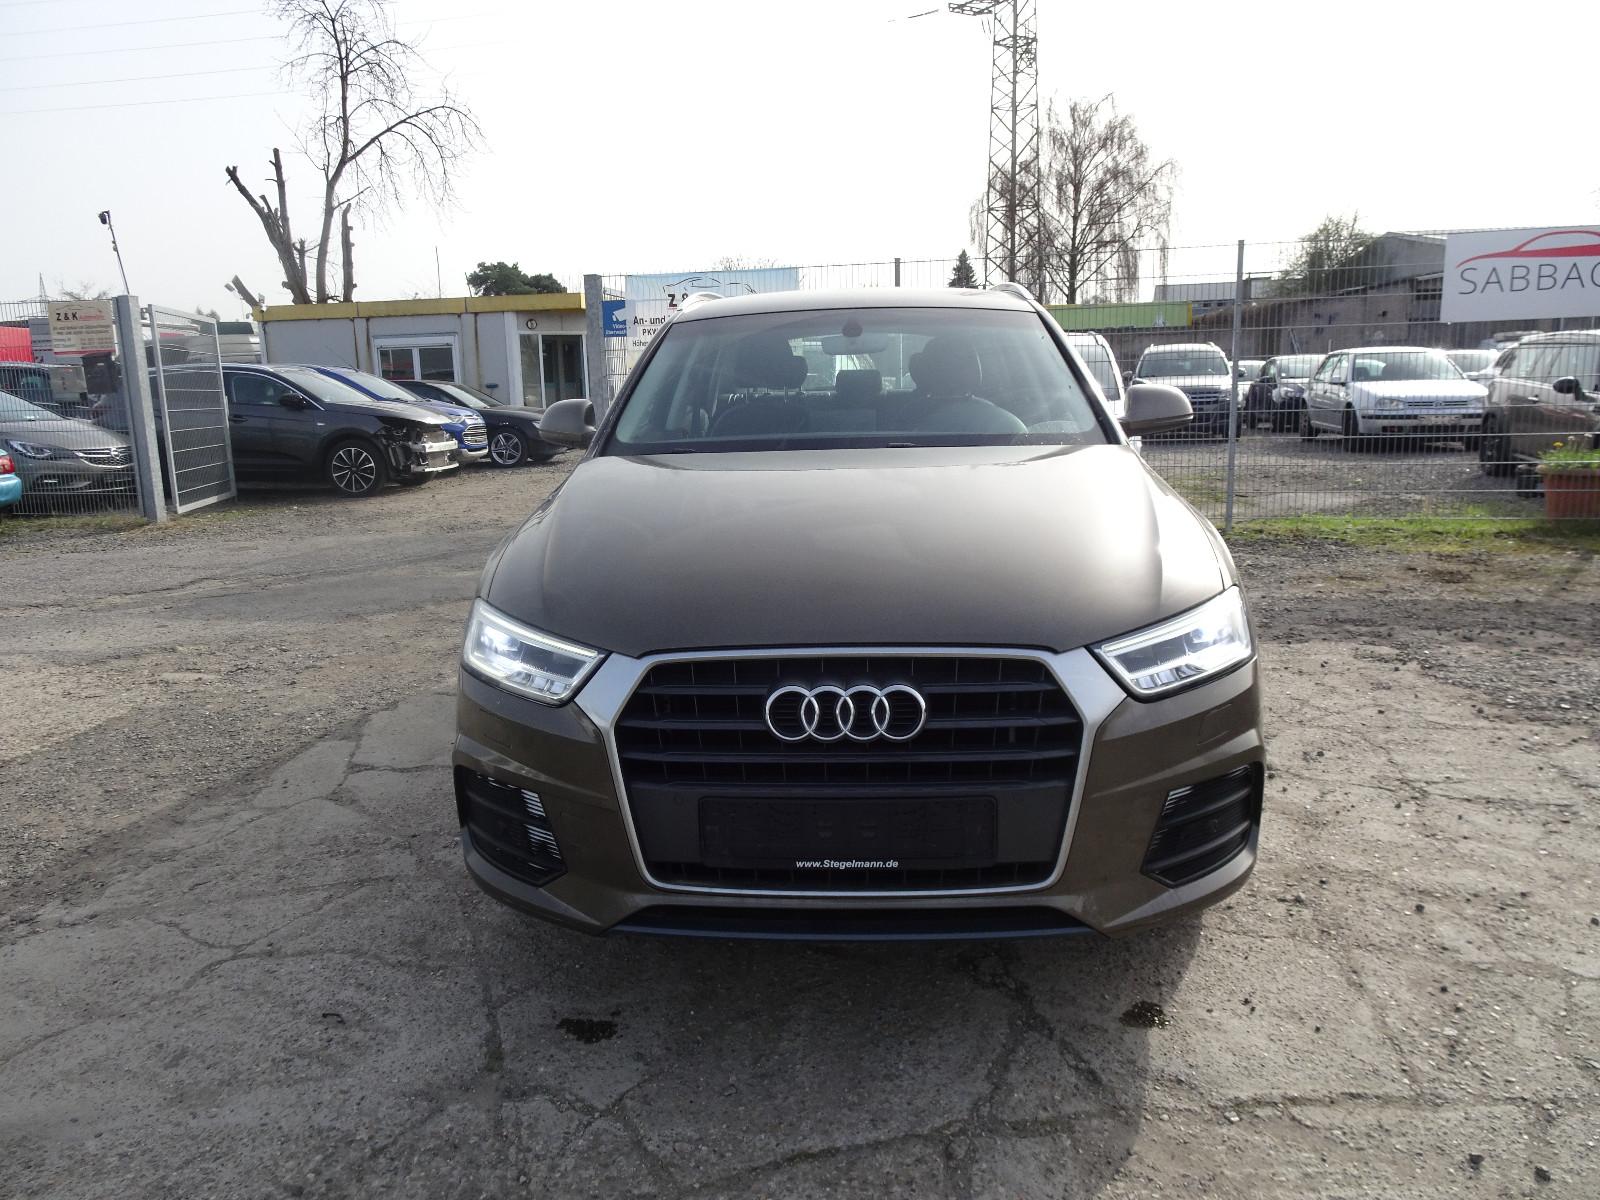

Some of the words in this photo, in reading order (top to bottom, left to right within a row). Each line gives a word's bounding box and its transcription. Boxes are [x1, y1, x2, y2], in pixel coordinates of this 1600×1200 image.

[667, 293, 677, 307] Z
[55, 312, 62, 320] Z
[63, 312, 70, 320] &
[71, 311, 78, 320] K
[633, 315, 648, 325] An-
[649, 315, 666, 325] und
[796, 859, 899, 869] www.Stegelmann.de
